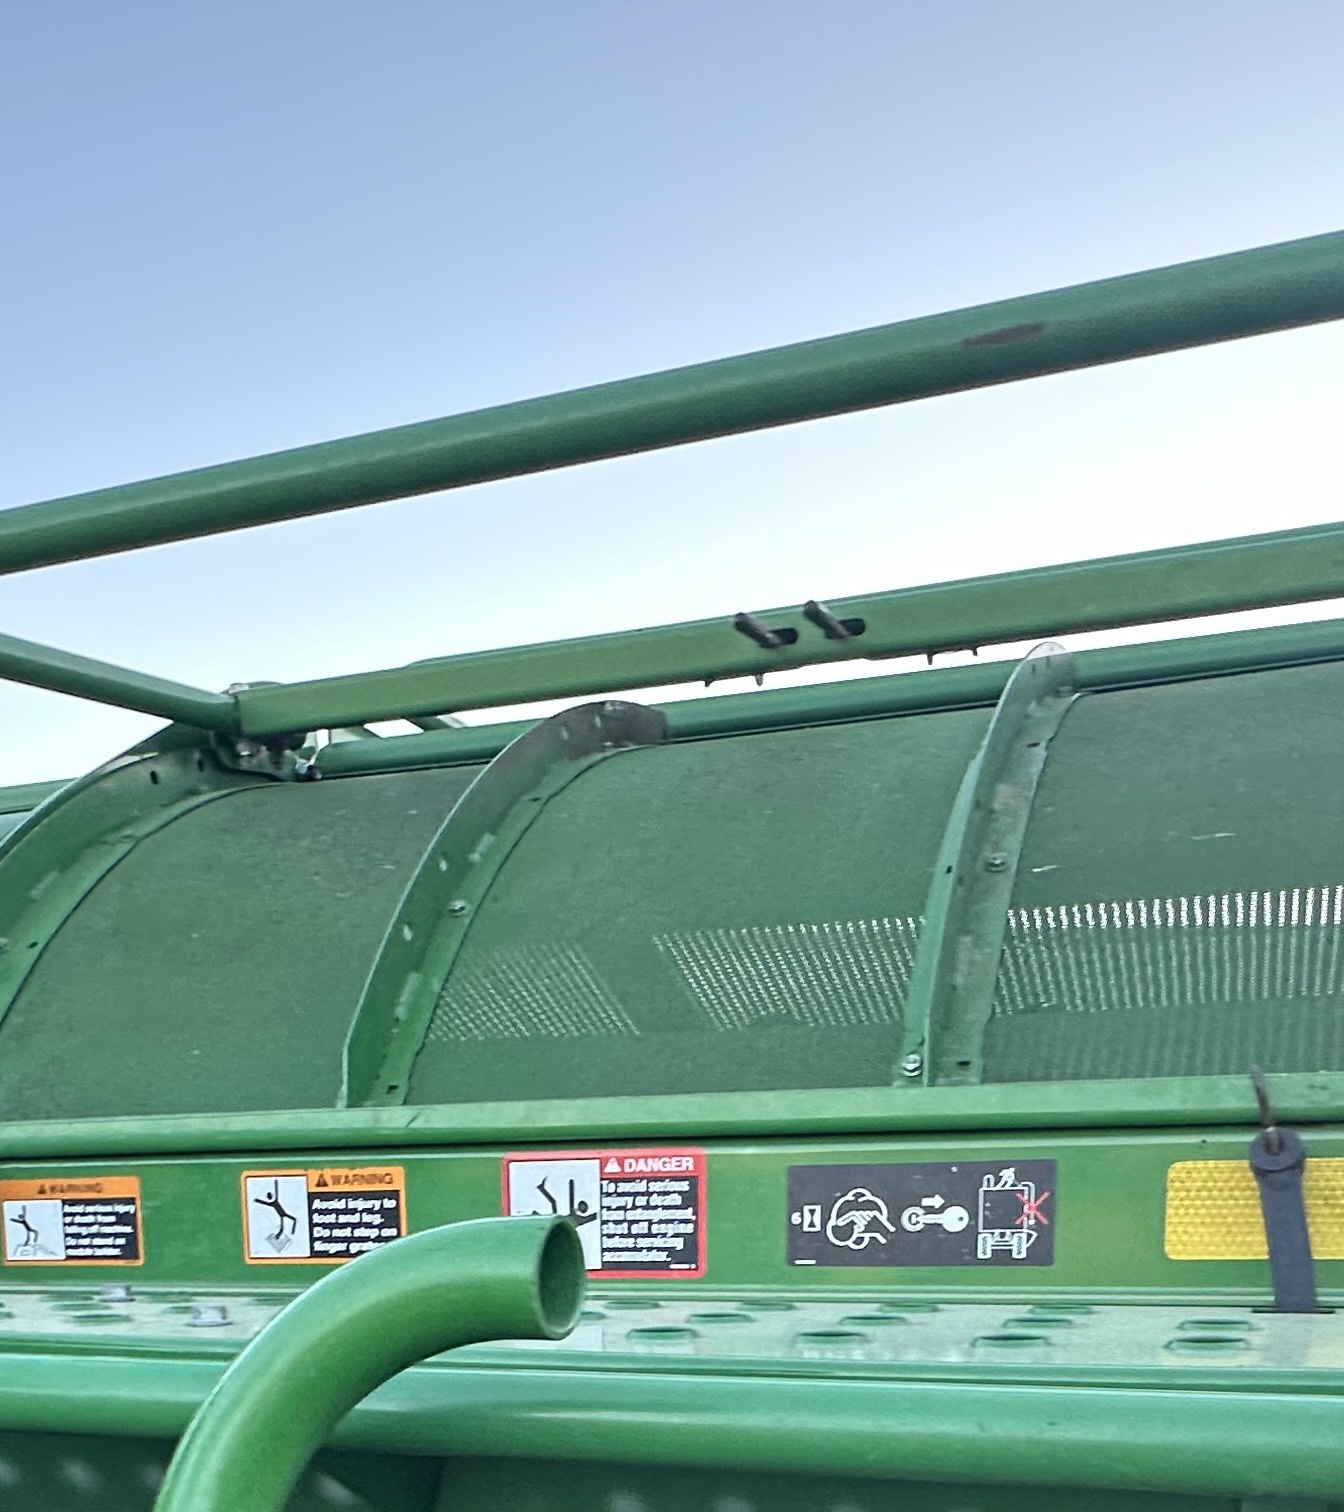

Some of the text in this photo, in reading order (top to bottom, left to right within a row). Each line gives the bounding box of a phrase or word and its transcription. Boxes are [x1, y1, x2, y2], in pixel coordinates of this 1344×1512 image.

[623, 1157, 695, 1173] DANGER
[329, 1173, 394, 1186] WARNING
[601, 1179, 690, 1193] To avoid serious
[49, 1184, 103, 1194] WARNING
[312, 1198, 397, 1210] Avoid injury to
[601, 1193, 683, 1209] injury or death
[312, 1212, 385, 1225] foot and leg.
[601, 1208, 625, 1220] from
[791, 1212, 802, 1225] 6
[313, 1227, 398, 1239] Do not step on
[602, 1221, 695, 1236] shut off engine
[602, 1236, 635, 1248] before
